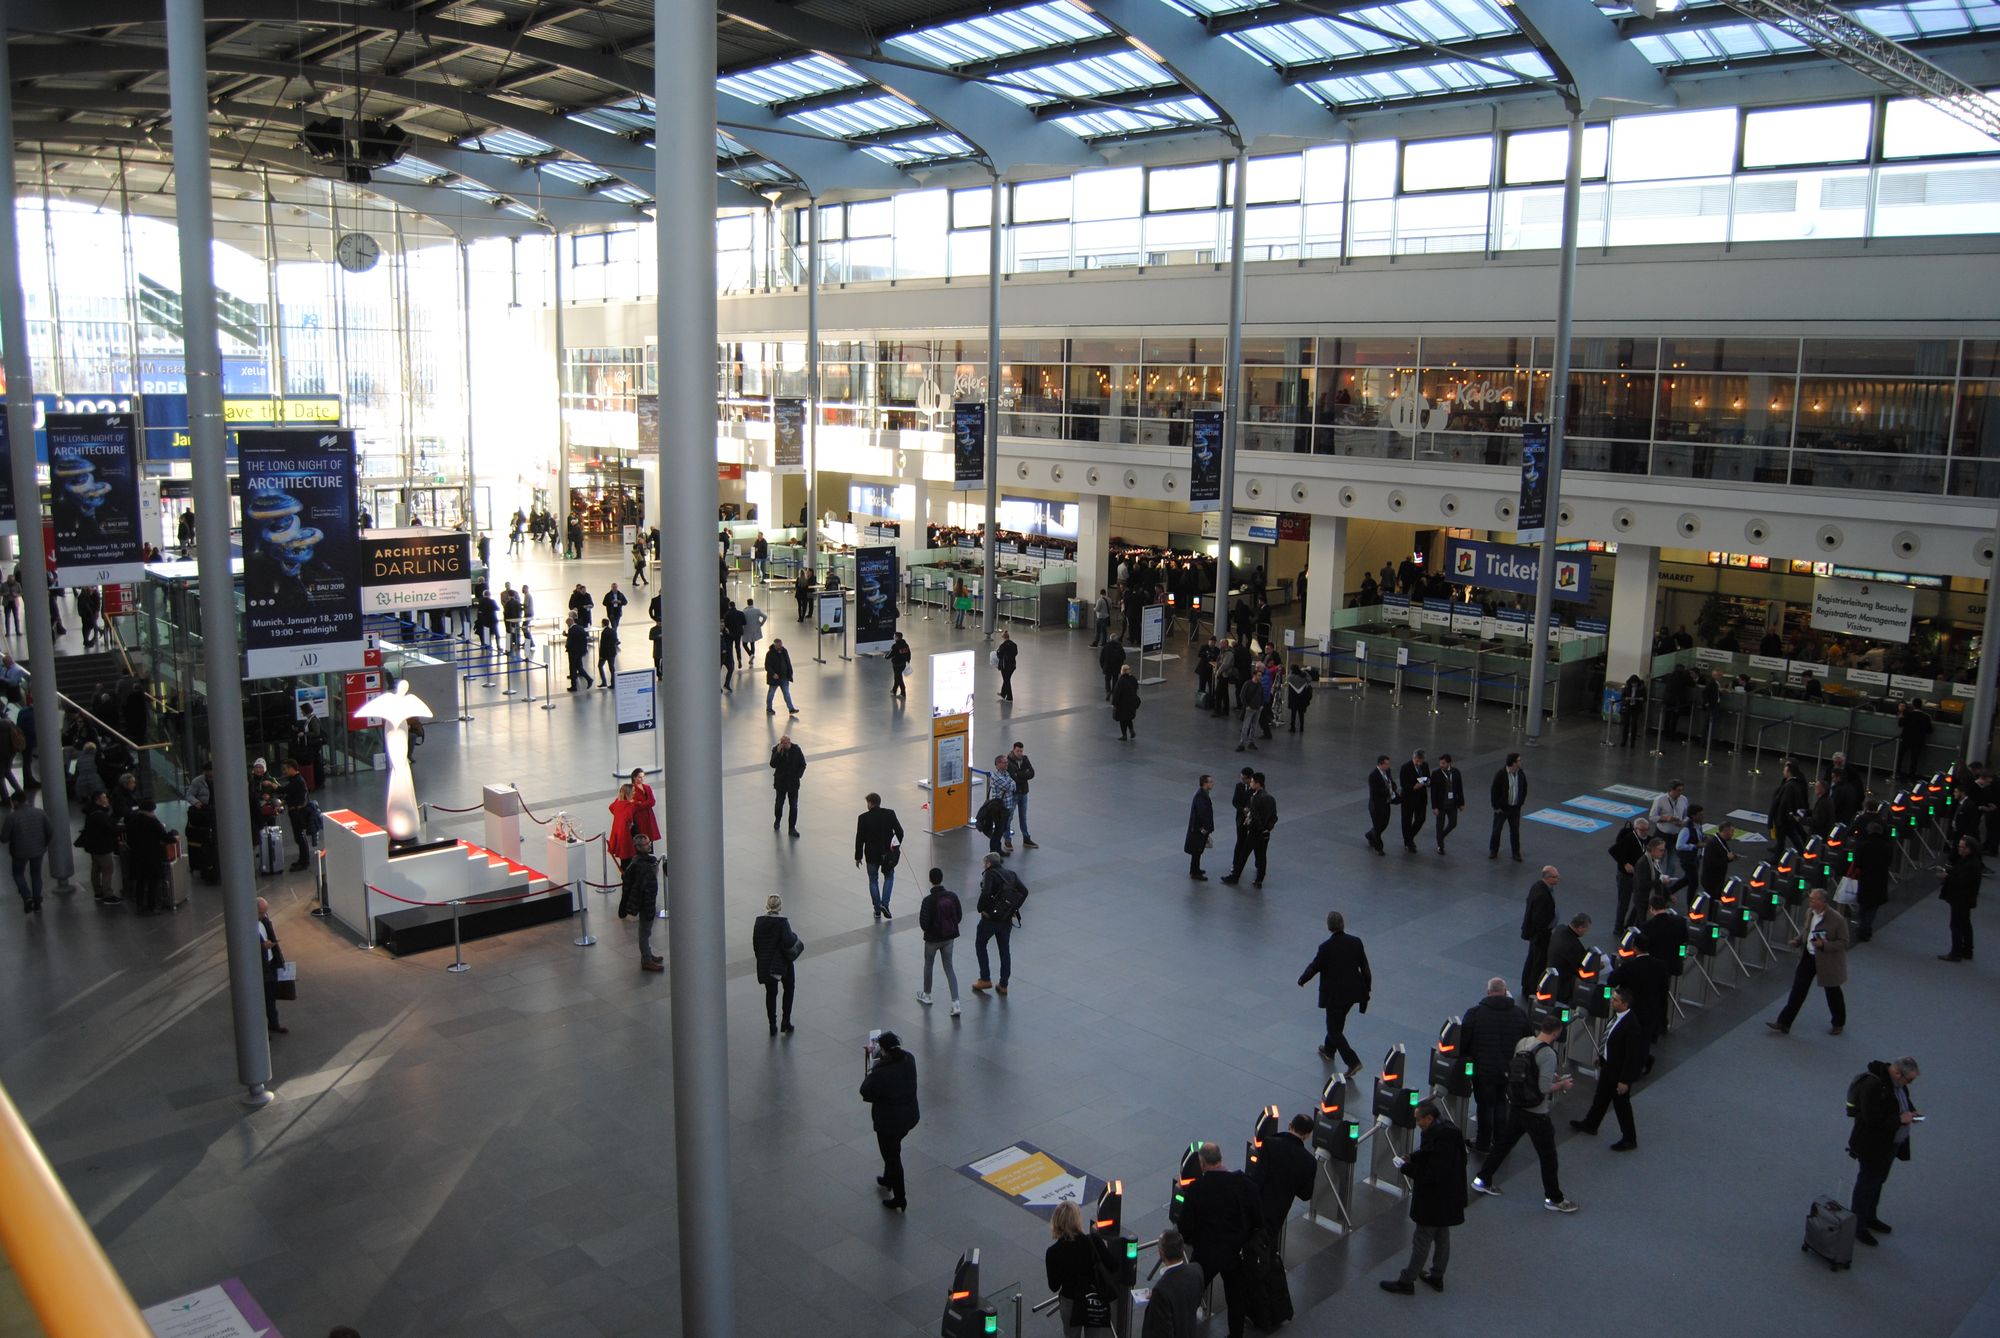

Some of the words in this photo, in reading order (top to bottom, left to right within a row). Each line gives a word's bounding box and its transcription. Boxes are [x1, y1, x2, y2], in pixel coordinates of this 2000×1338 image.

[1455, 381, 1514, 411] Käfer
[224, 406, 254, 418] ave
[295, 403, 330, 419] Date
[53, 435, 67, 443] THE
[68, 435, 89, 443] LONG
[90, 434, 113, 442] NIGHT
[115, 433, 124, 442] OF
[54, 445, 126, 456] ARCHITECTURE
[246, 460, 265, 472] THE
[268, 460, 295, 471] LONG
[298, 459, 328, 471] NIGHT
[330, 459, 342, 470] OF
[247, 475, 343, 490] ARCHITECTURE
[375, 558, 460, 577] DARLING
[1485, 553, 1541, 581] Ticket
[394, 590, 437, 604] Heinze
[1817, 593, 1874, 610] Registrierleitung
[1875, 600, 1908, 614] Besucher
[252, 618, 285, 627] Munich,
[287, 616, 318, 625] January
[320, 614, 332, 623] 18,
[333, 613, 354, 621] 2019
[1816, 606, 1857, 620] Registration
[1859, 613, 1907, 628] Management
[270, 629, 294, 637] 19:00
[303, 625, 338, 635] midnight
[1846, 621, 1872, 633] Visitors
[300, 653, 318, 667] AD
